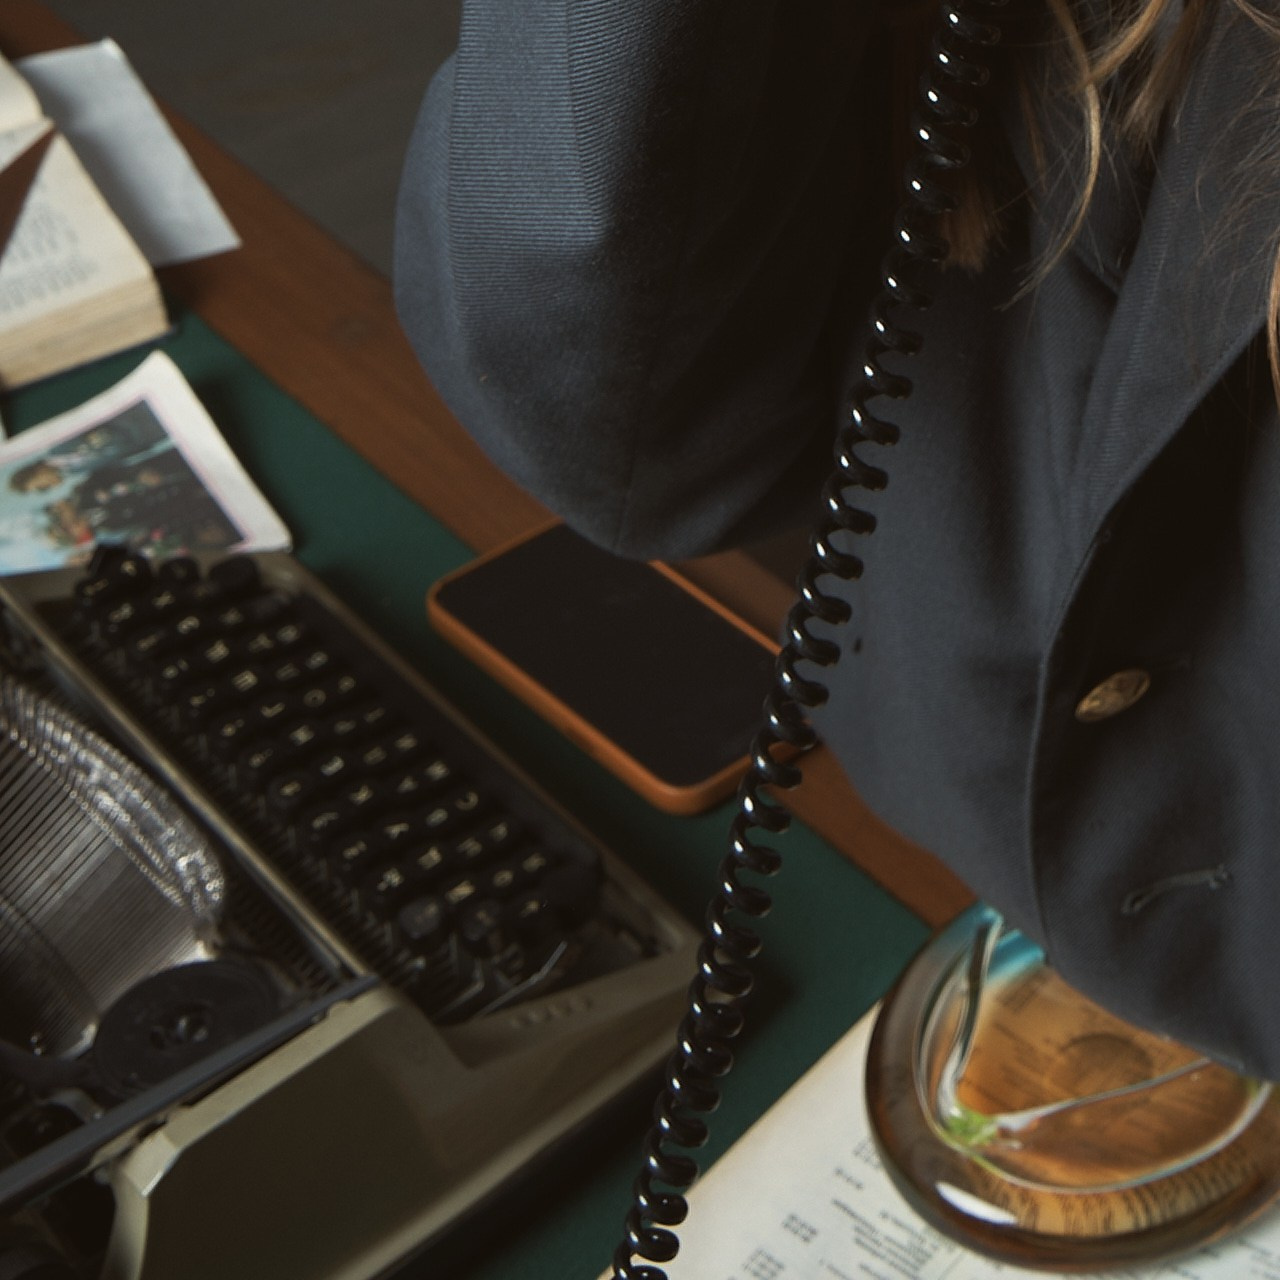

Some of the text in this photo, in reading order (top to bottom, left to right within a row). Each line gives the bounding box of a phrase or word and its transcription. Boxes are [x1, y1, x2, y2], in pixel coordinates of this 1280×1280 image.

[235, 670, 257, 688] Ш
[303, 688, 327, 705] О
[261, 702, 284, 718] Г
[354, 786, 371, 803] К
[456, 791, 479, 810] С
[387, 823, 408, 837] У
